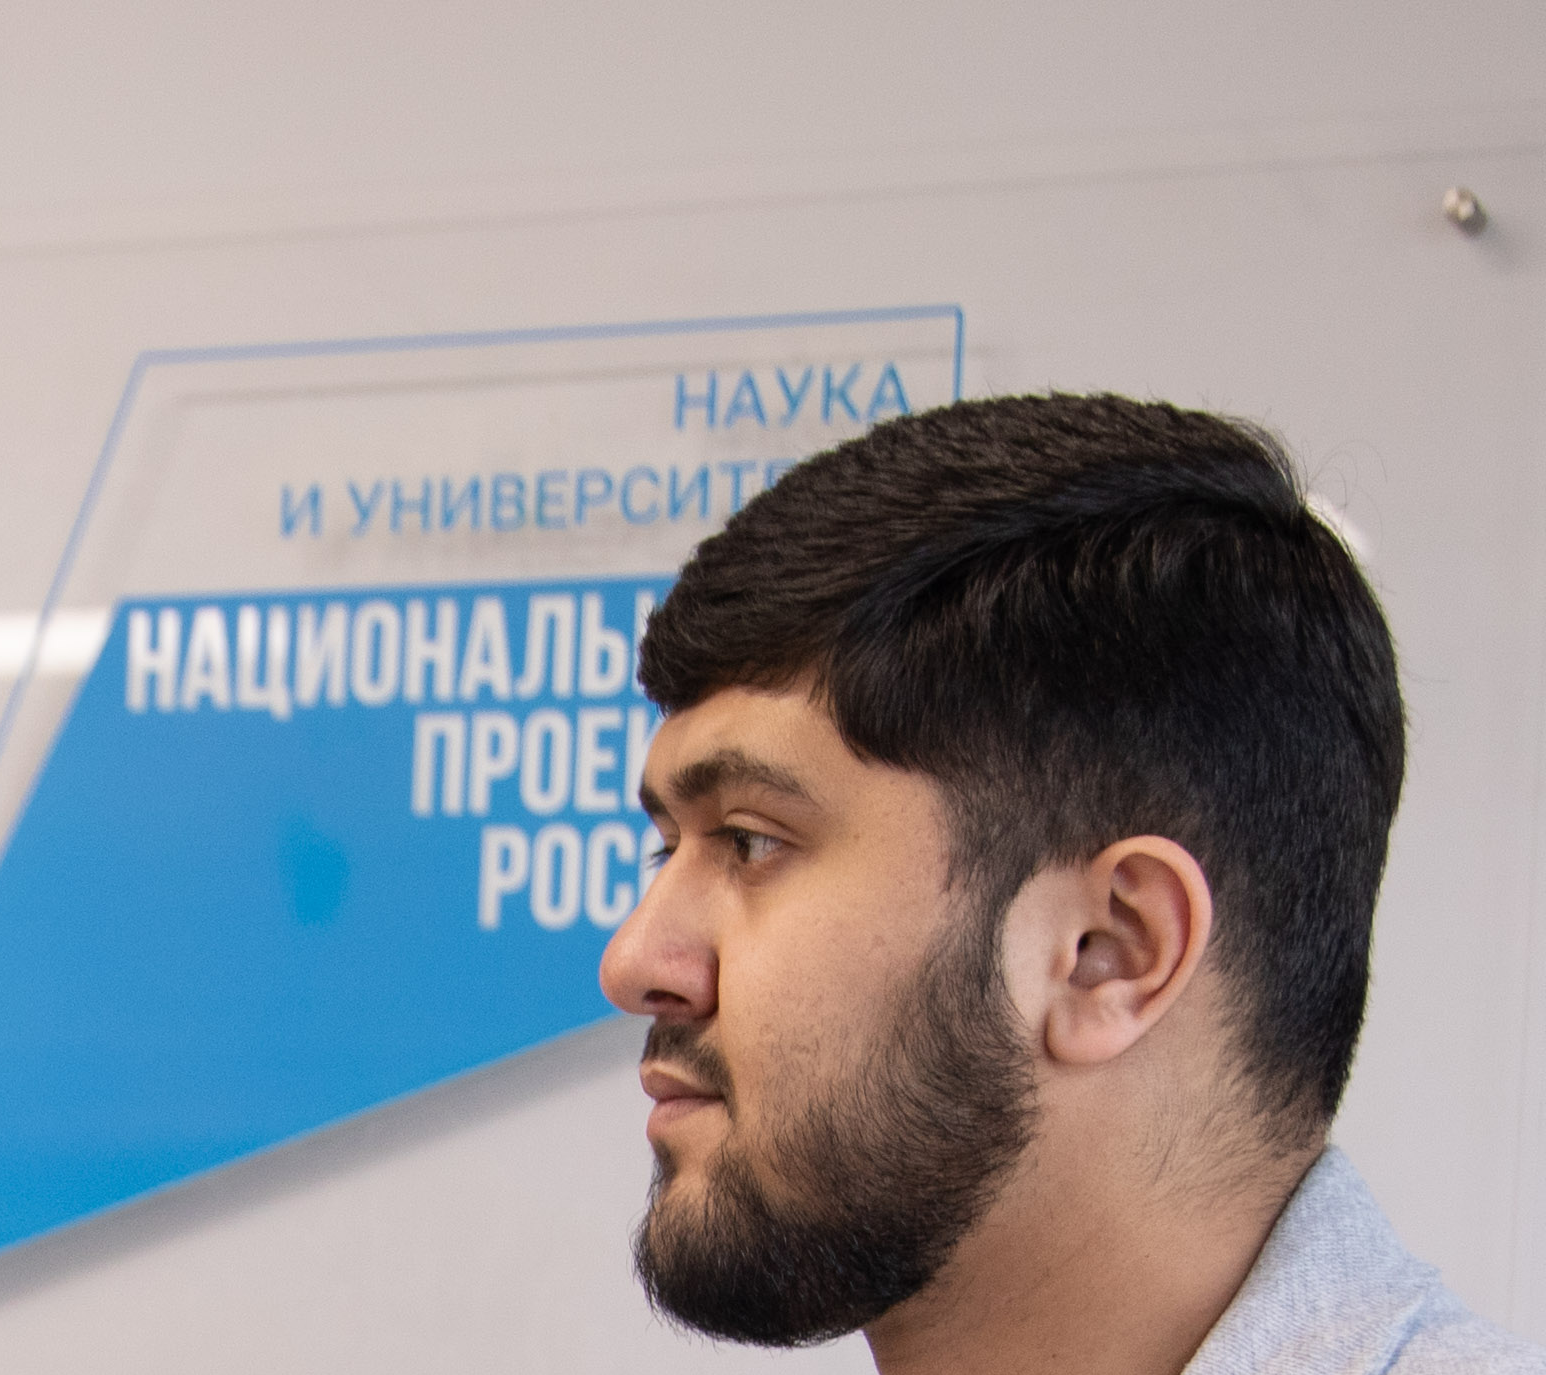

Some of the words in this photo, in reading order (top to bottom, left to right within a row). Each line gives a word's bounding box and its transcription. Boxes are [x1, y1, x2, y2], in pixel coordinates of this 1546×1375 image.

[673, 362, 911, 430] НАУКА
[280, 482, 322, 538] И
[125, 590, 656, 721] НАЦИОНАЛЬ
